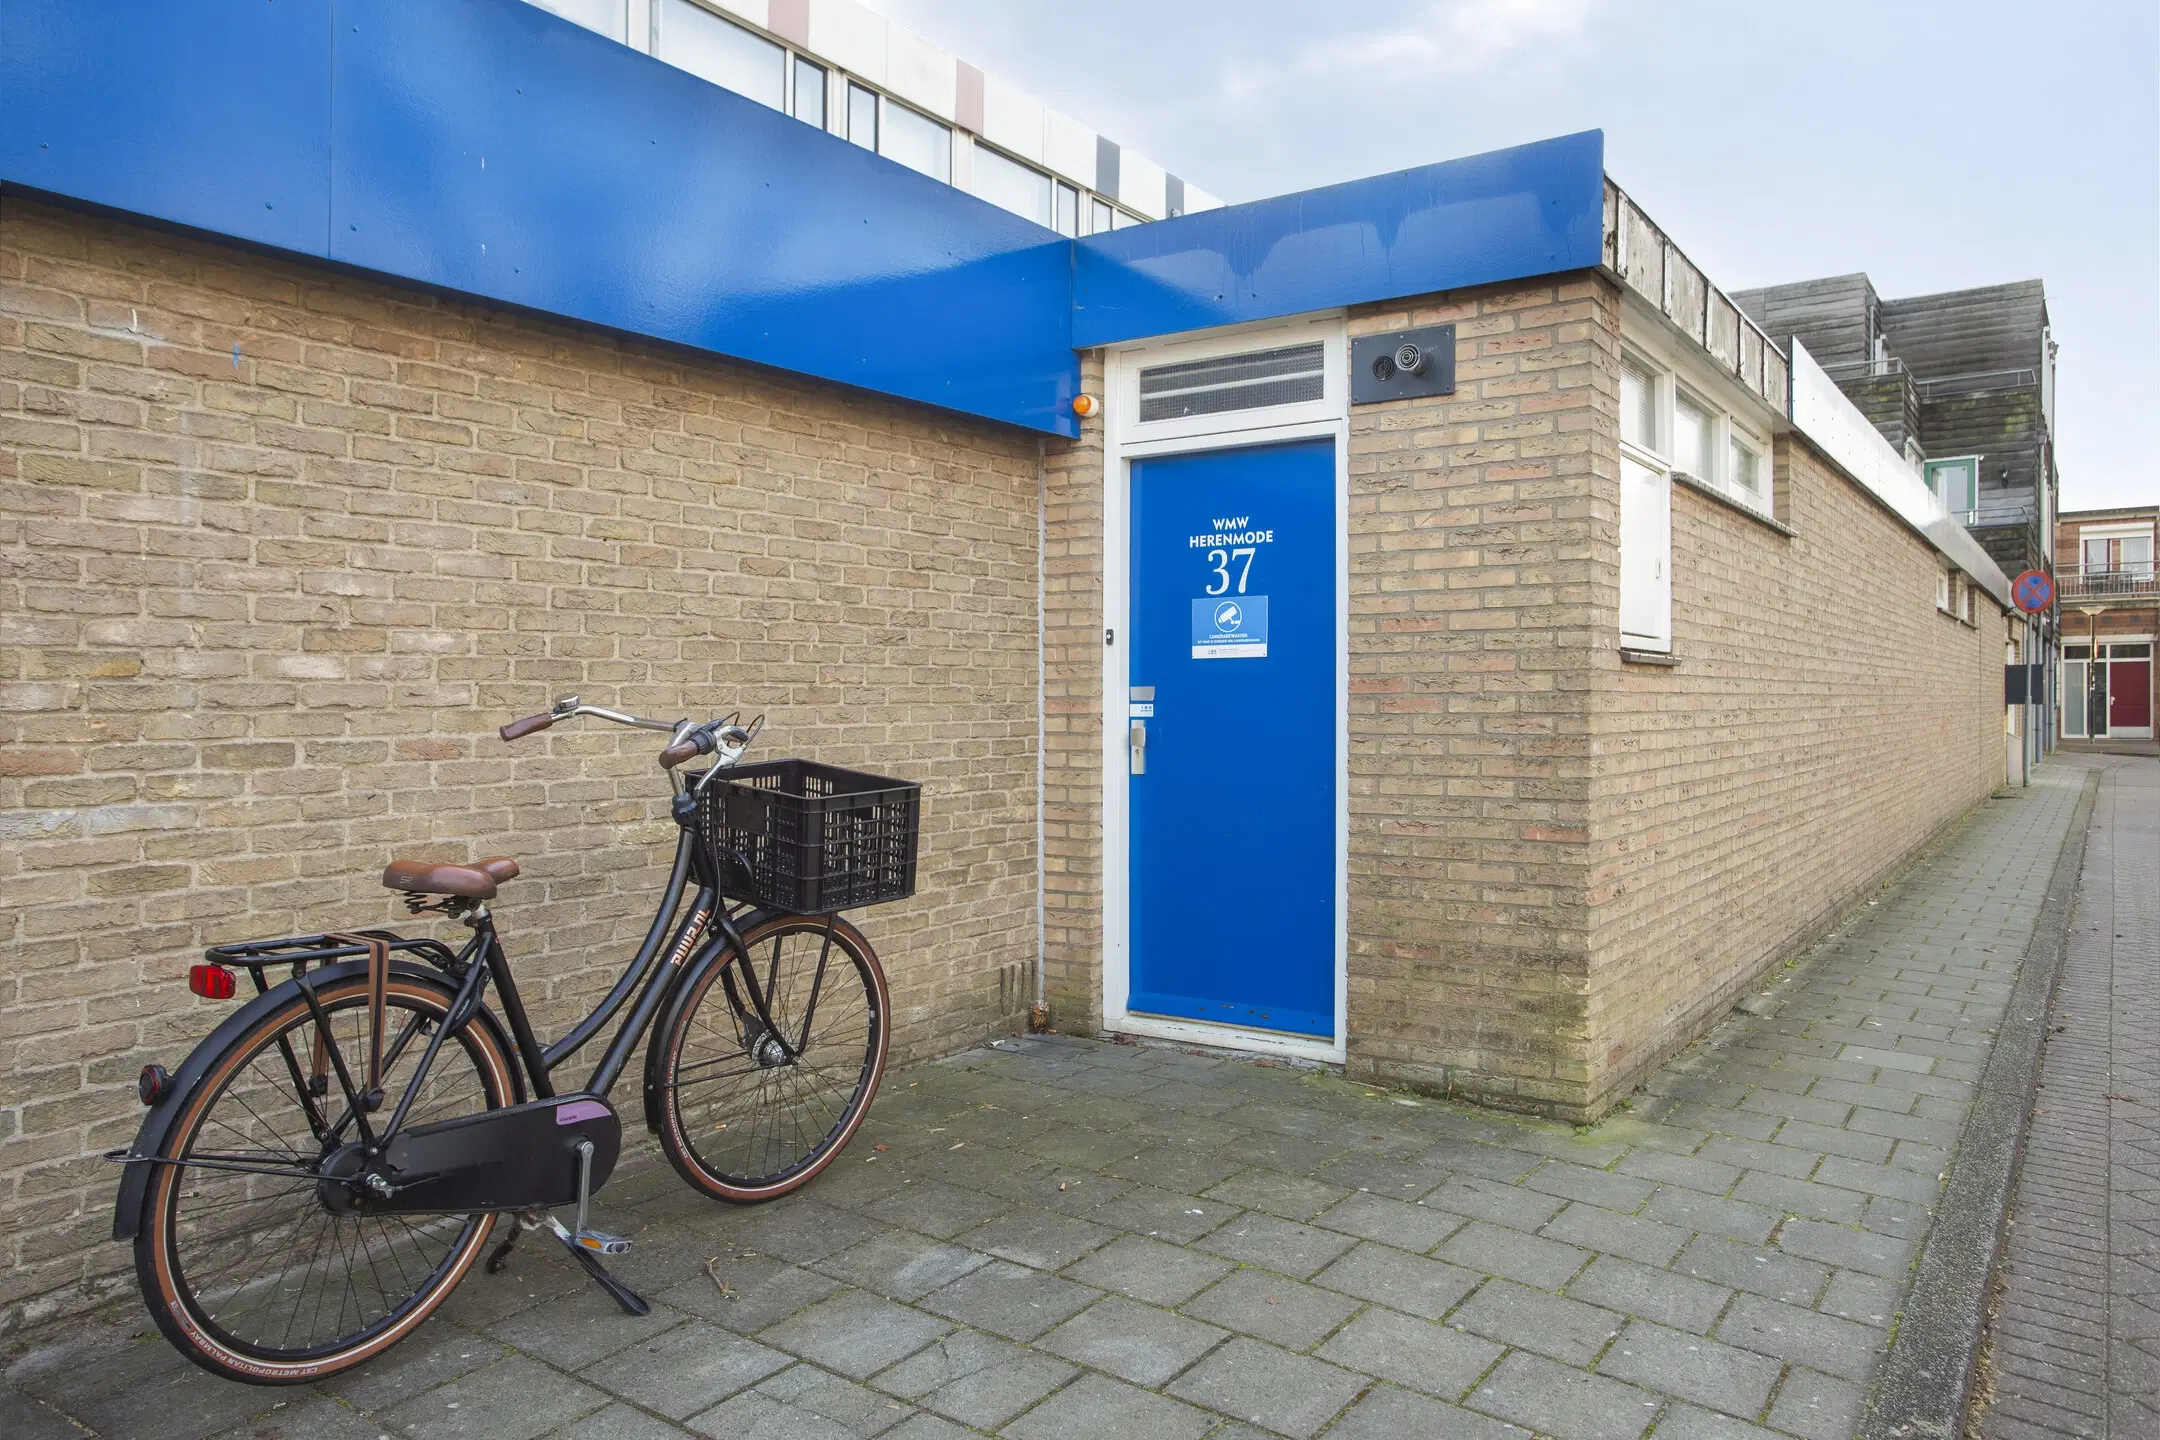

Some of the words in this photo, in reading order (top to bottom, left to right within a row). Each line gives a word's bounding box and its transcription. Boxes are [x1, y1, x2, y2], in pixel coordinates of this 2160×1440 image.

[1212, 516, 1249, 530] WMW
[1189, 530, 1274, 548] HERENMODE
[1205, 547, 1256, 595] 37
[190, 1331, 228, 1361] PALMBAY
[227, 1358, 300, 1376] METROPOLITAN
[301, 1367, 318, 1375] CST
